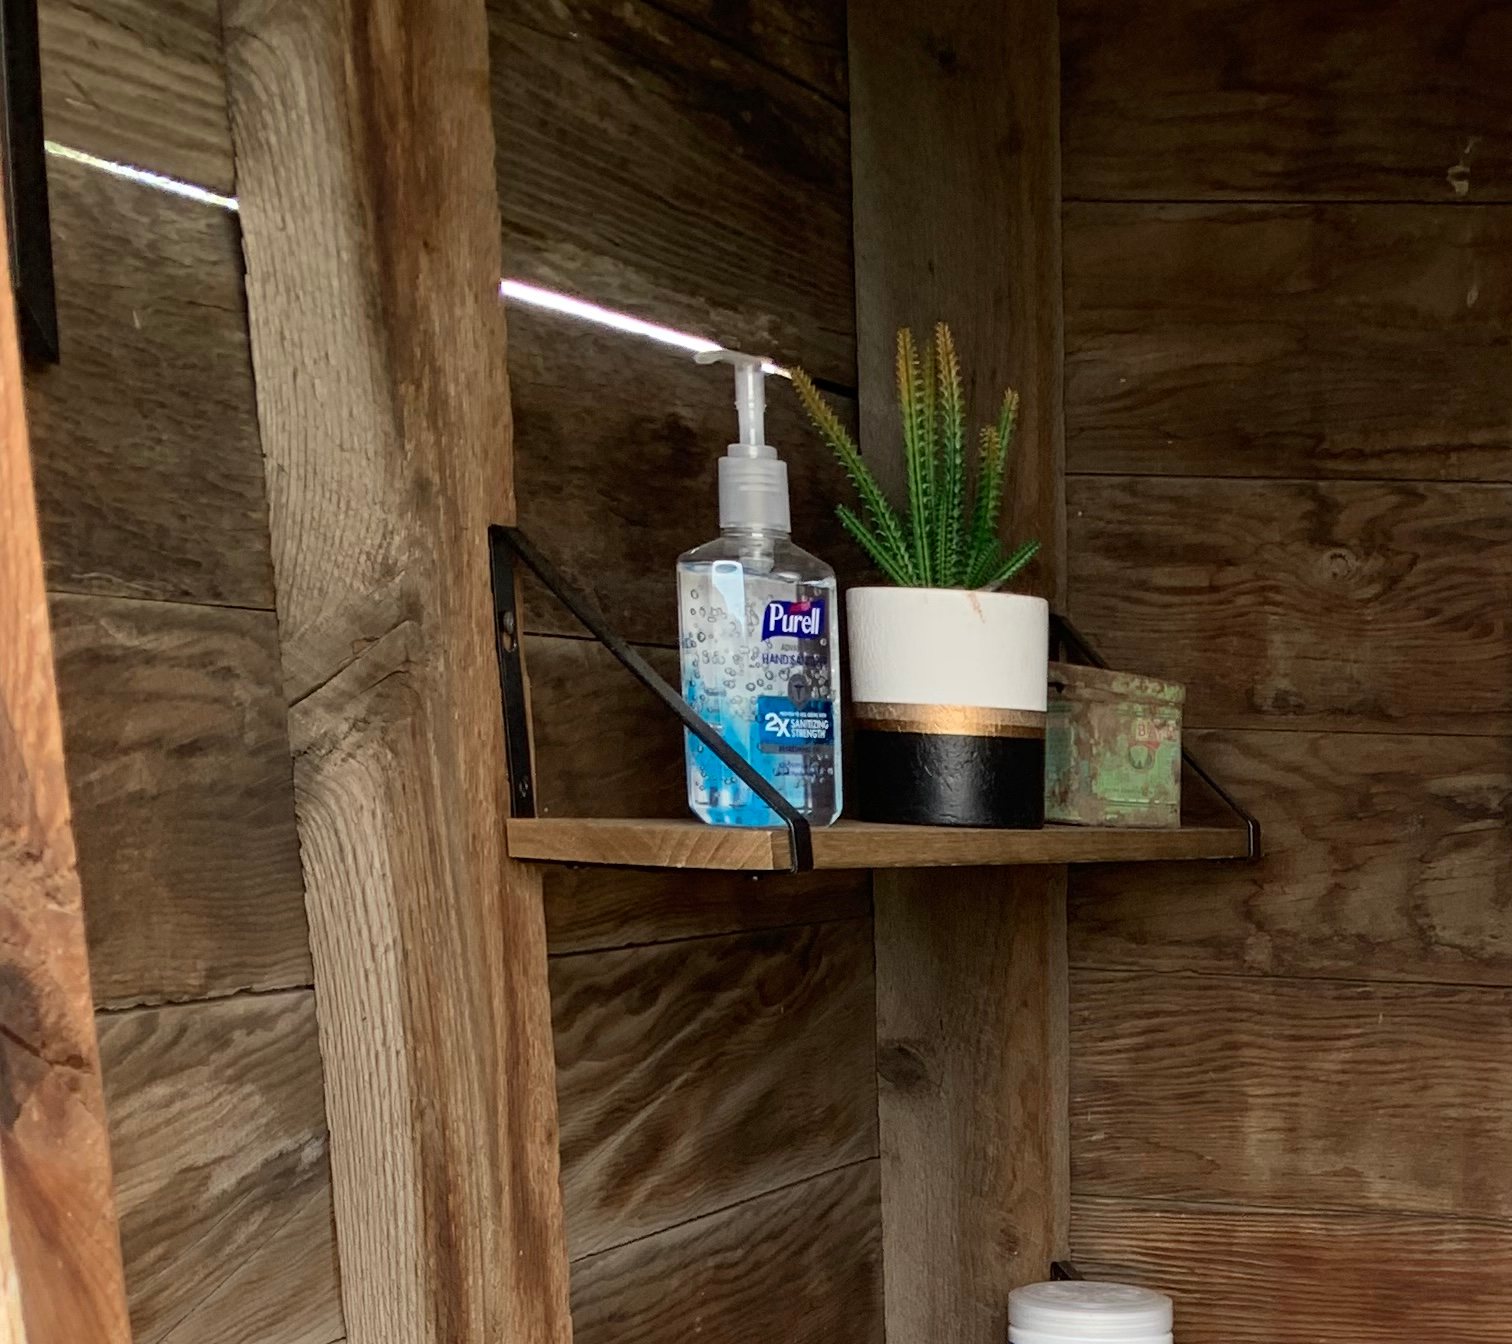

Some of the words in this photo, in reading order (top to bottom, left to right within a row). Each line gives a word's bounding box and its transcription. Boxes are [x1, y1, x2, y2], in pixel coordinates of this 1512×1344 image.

[769, 603, 820, 635] Purell
[762, 653, 789, 665] HAND
[764, 712, 791, 737] 2X
[791, 719, 829, 729] SANITIZING
[791, 729, 827, 738] STRENGTH
